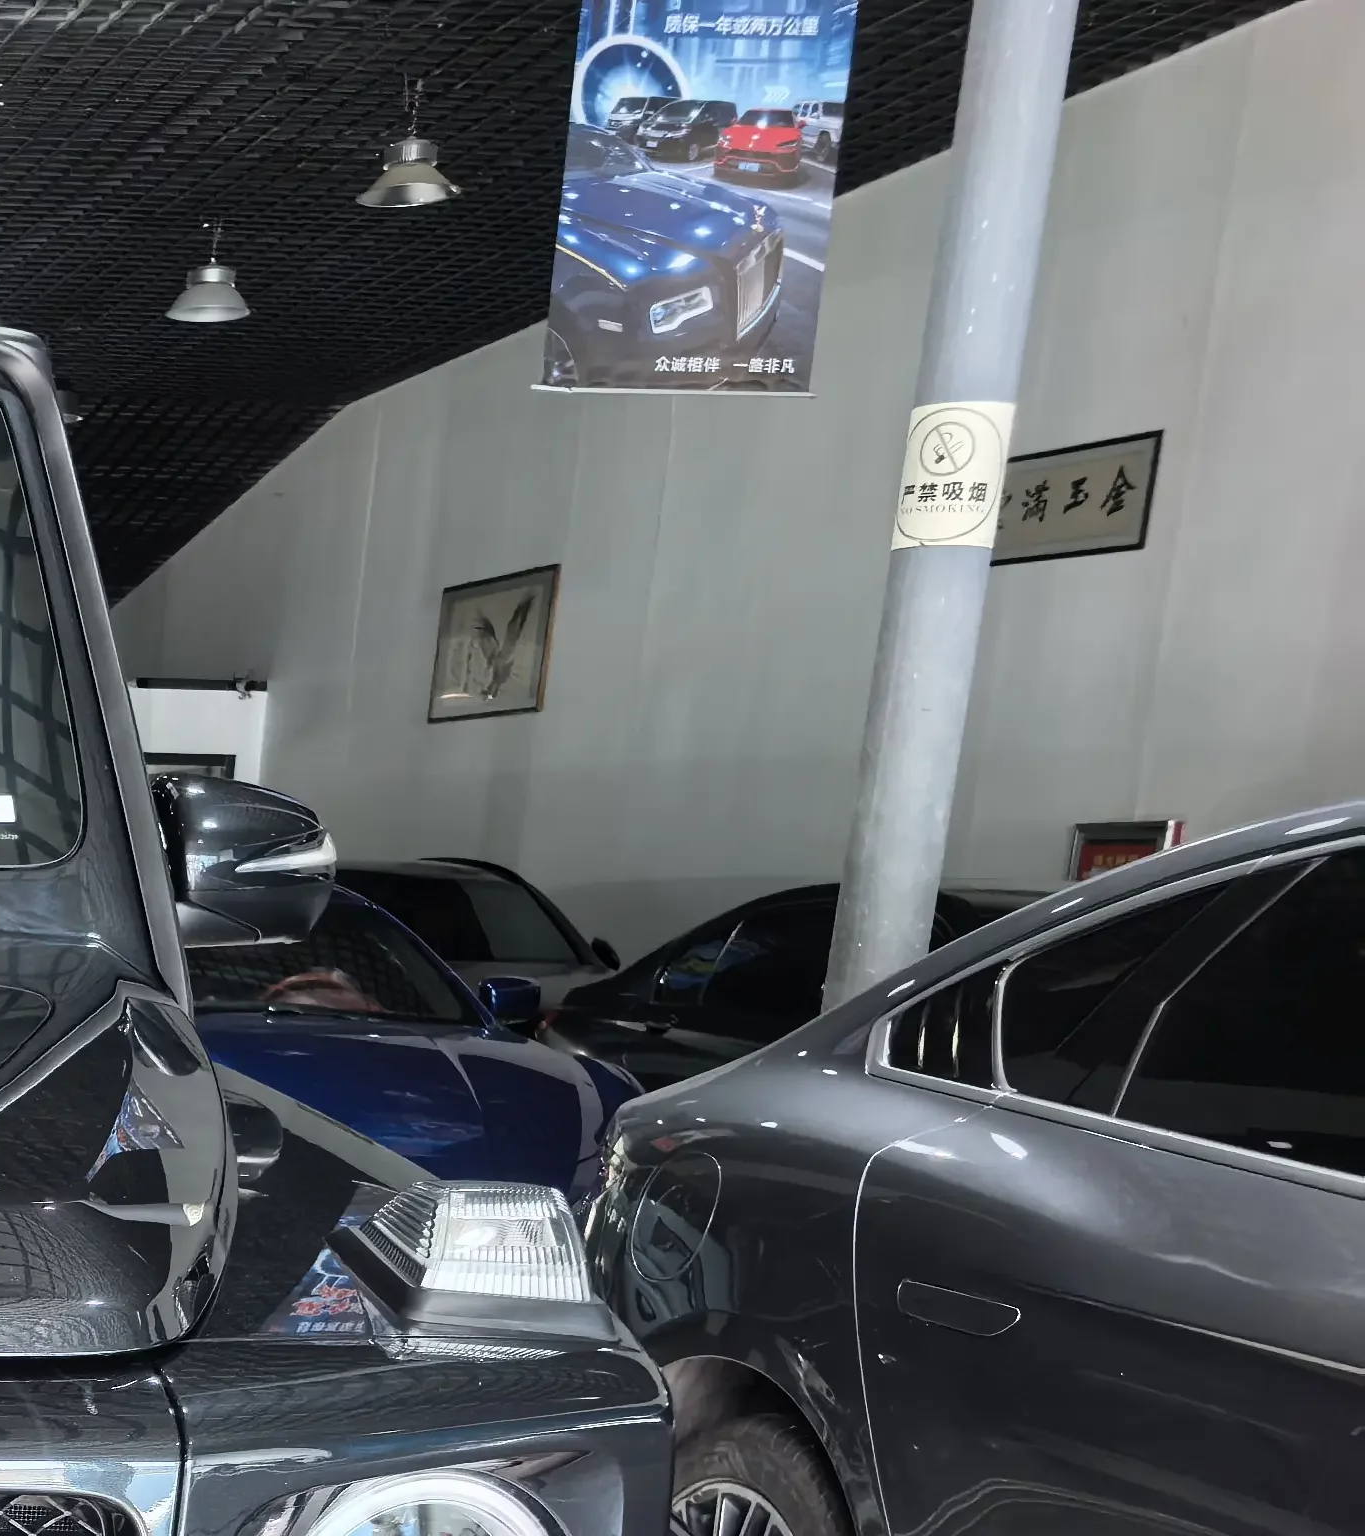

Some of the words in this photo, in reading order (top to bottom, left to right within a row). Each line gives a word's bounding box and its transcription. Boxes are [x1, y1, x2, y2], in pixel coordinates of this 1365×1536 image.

[664, 14, 820, 36] 质保一年或两万公里
[654, 355, 722, 373] 众诚相伴
[732, 357, 795, 374] 一路非凡
[901, 481, 988, 505] 严禁吸烟
